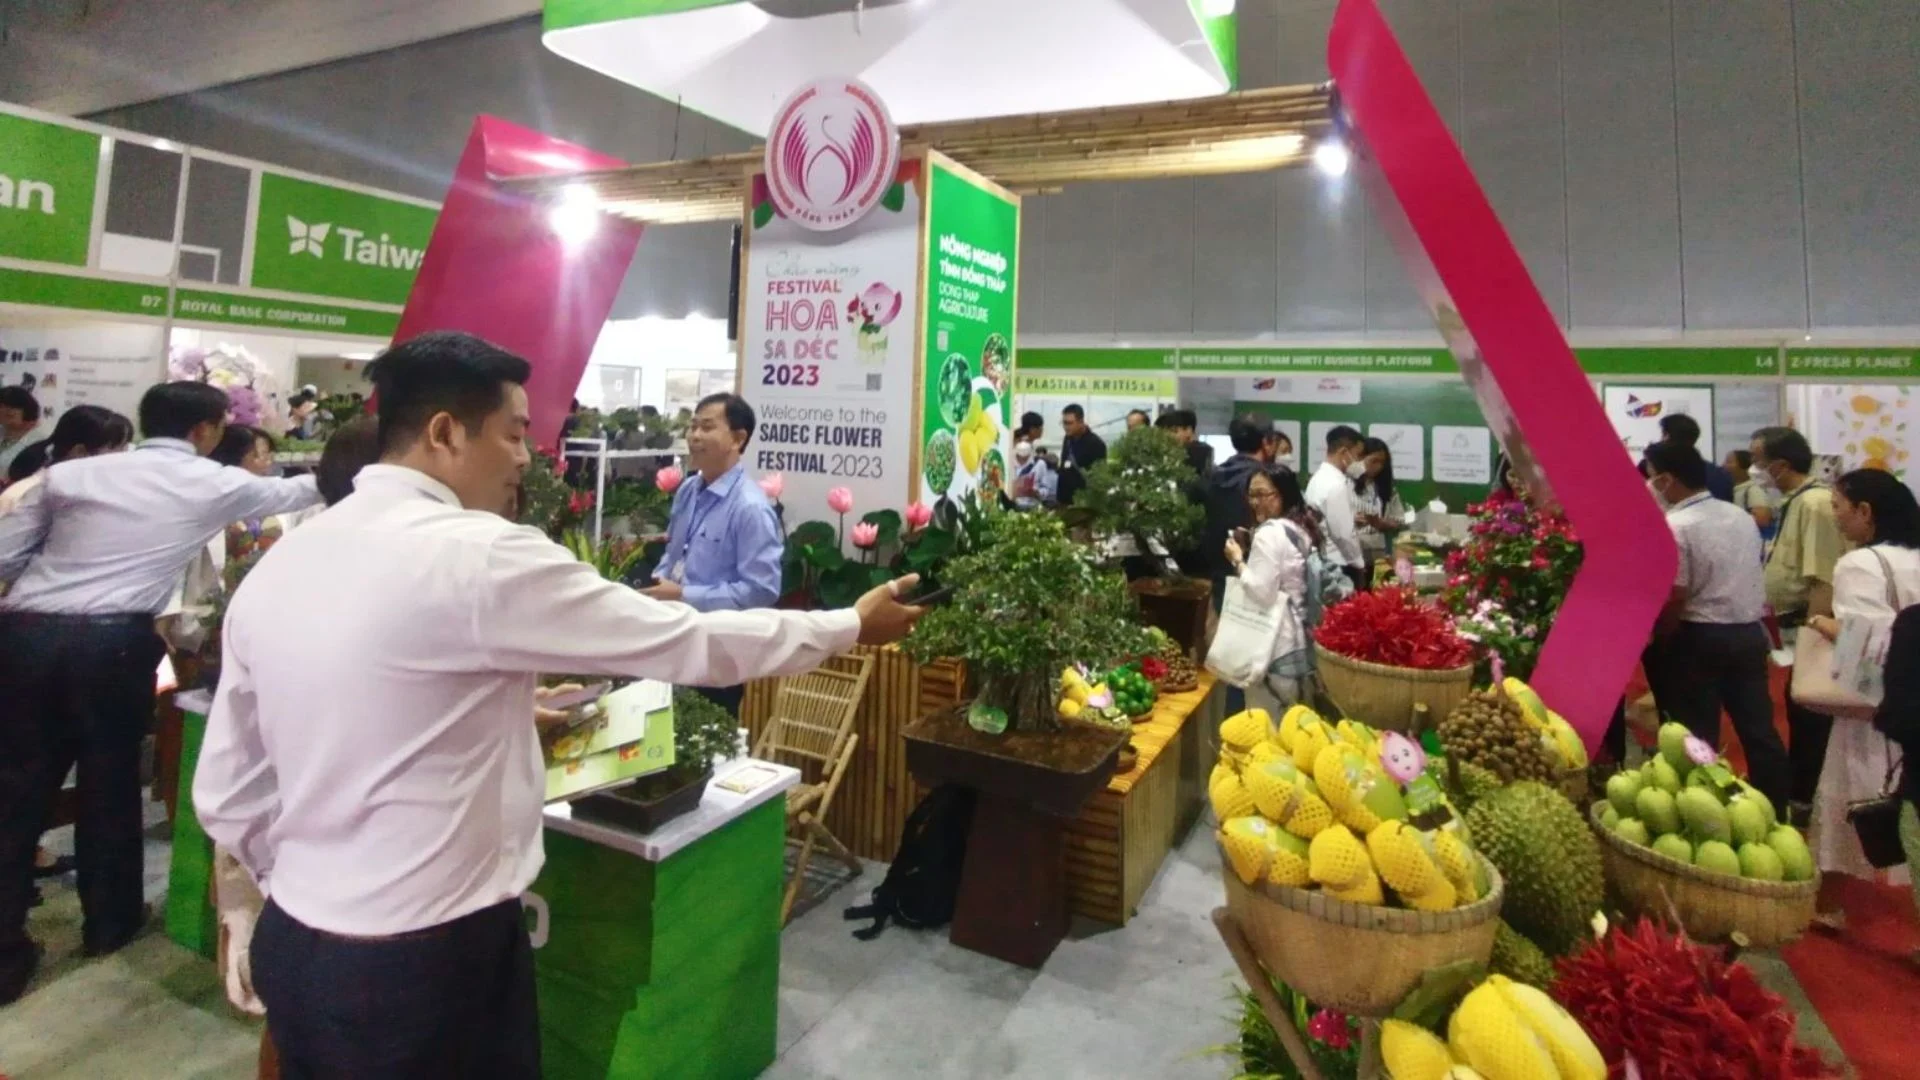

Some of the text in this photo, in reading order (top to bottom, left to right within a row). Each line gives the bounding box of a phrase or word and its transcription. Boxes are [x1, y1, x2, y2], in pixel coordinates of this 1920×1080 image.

[336, 225, 425, 271] Taiw
[767, 278, 842, 295] FESTIVAL
[180, 299, 347, 327] ROYAL BASE CORPORATION
[765, 298, 839, 331] HOA
[938, 297, 989, 323] AGRICULTURE
[763, 338, 787, 360] SA
[1248, 355, 1290, 366] VIETNAM
[1324, 356, 1373, 366] BUSINESS
[1376, 357, 1433, 367] PLATFORM
[762, 364, 820, 386] 2023
[1026, 378, 1087, 390] PLASTIKA
[760, 403, 887, 424] Welcome to the
[759, 422, 883, 448] SADEC FLOWER
[757, 450, 884, 479] FESTIVAL 2023
